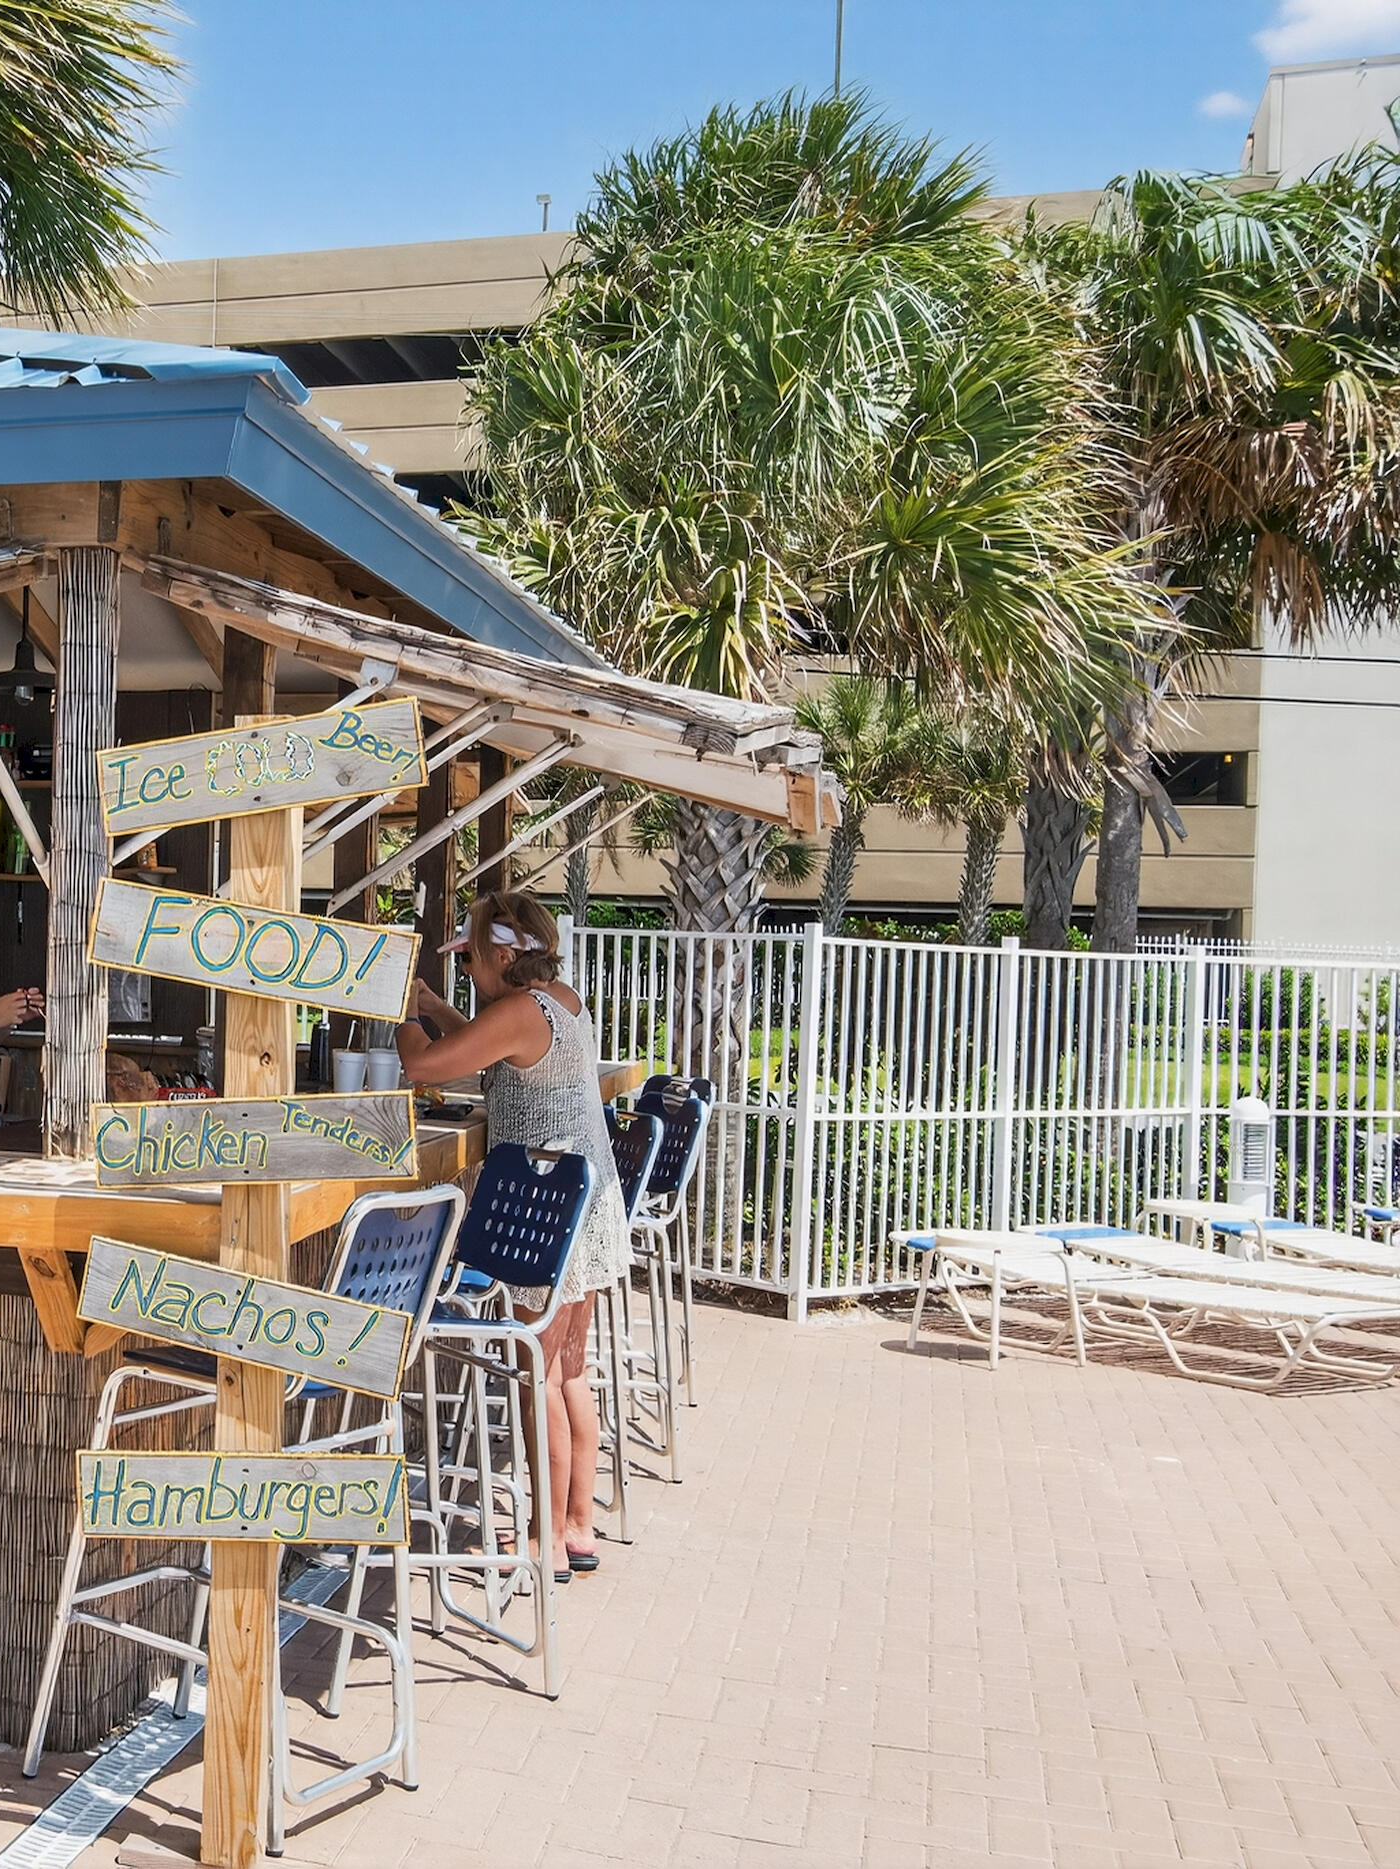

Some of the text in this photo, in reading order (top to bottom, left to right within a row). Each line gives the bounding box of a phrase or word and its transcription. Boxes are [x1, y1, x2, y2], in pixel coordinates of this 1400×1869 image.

[106, 710, 420, 815] Ice COLD Beer!
[135, 895, 388, 997] FOOD!
[95, 1099, 415, 1176] Chicken Tenders!
[84, 1455, 403, 1542] Hamburgers!
